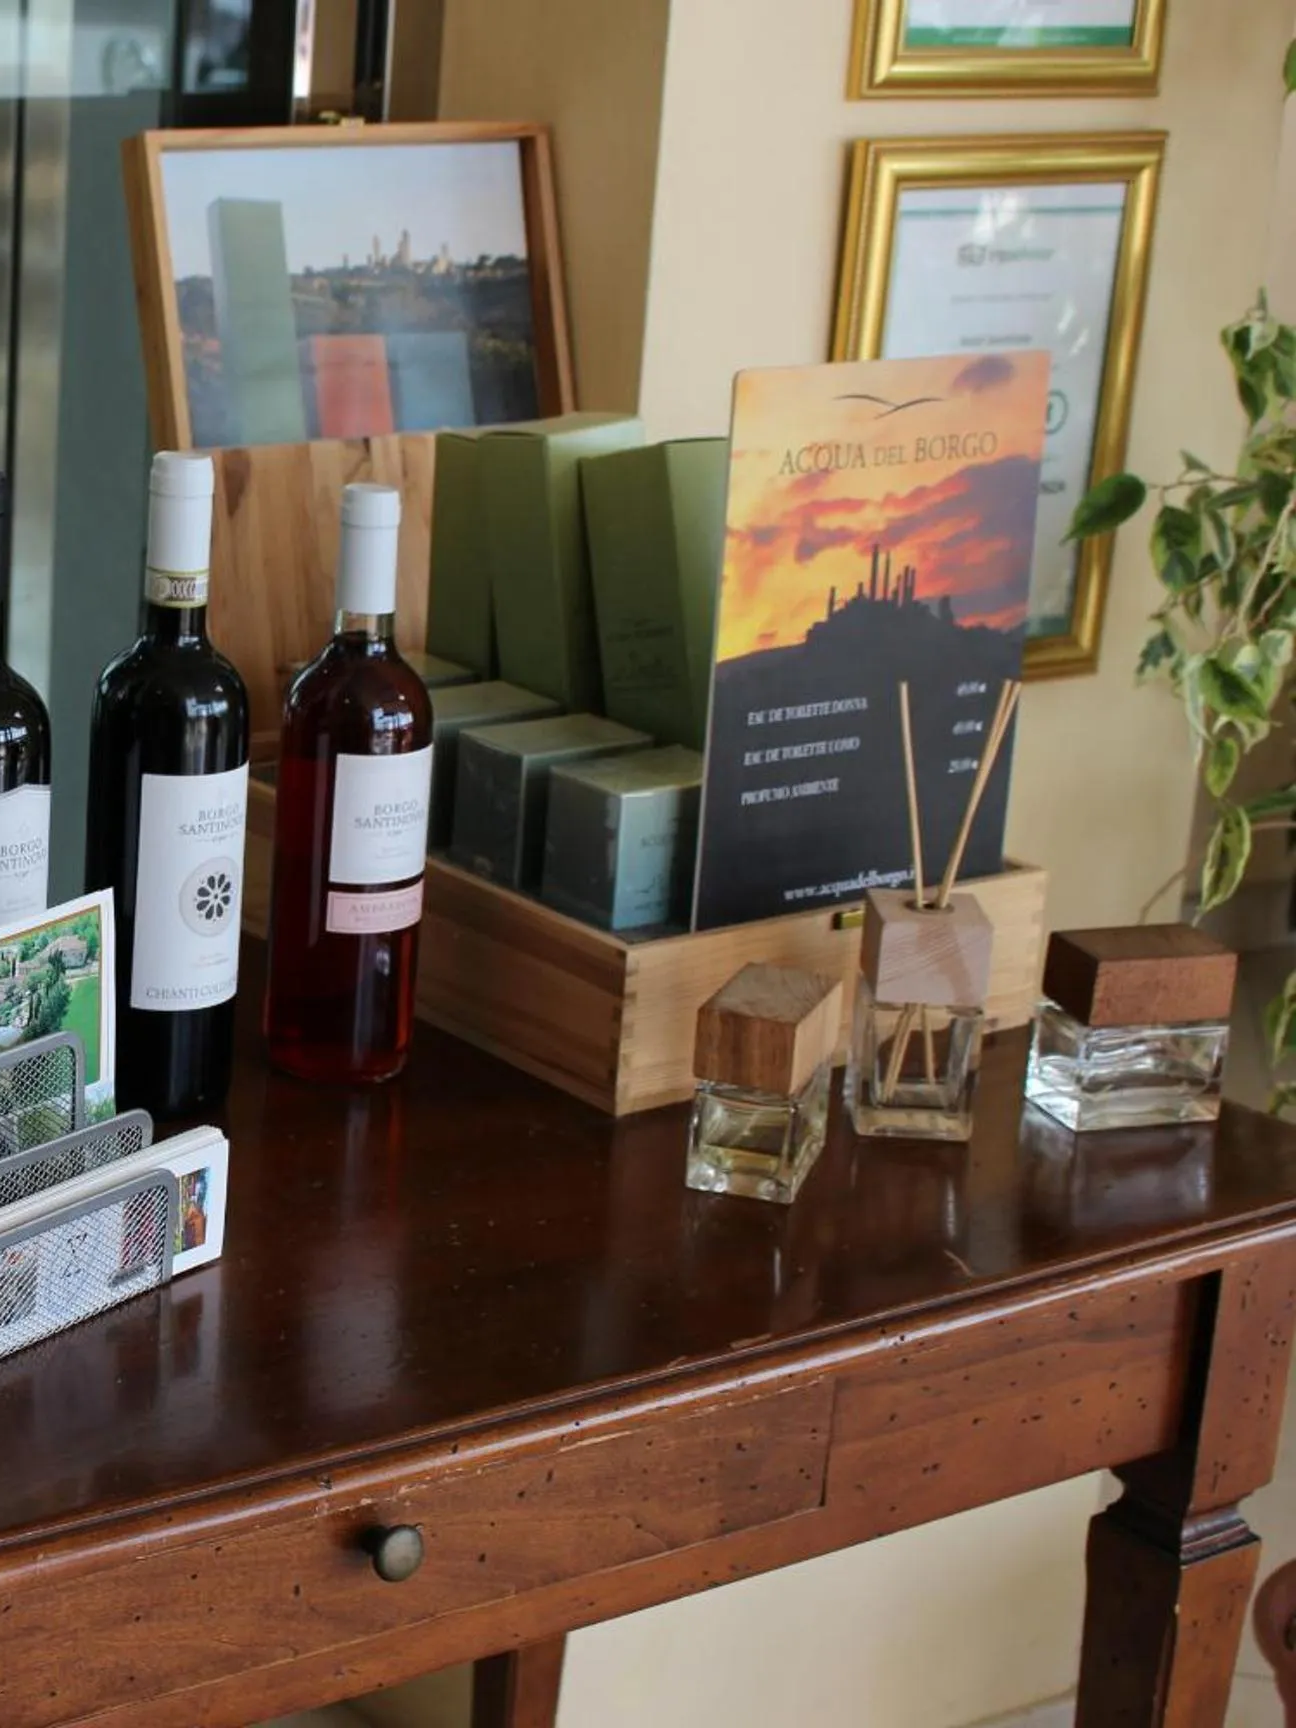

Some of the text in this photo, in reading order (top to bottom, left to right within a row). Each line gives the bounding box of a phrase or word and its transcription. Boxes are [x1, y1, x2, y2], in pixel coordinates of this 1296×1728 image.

[779, 432, 998, 475] ACQUA DEL BORGO
